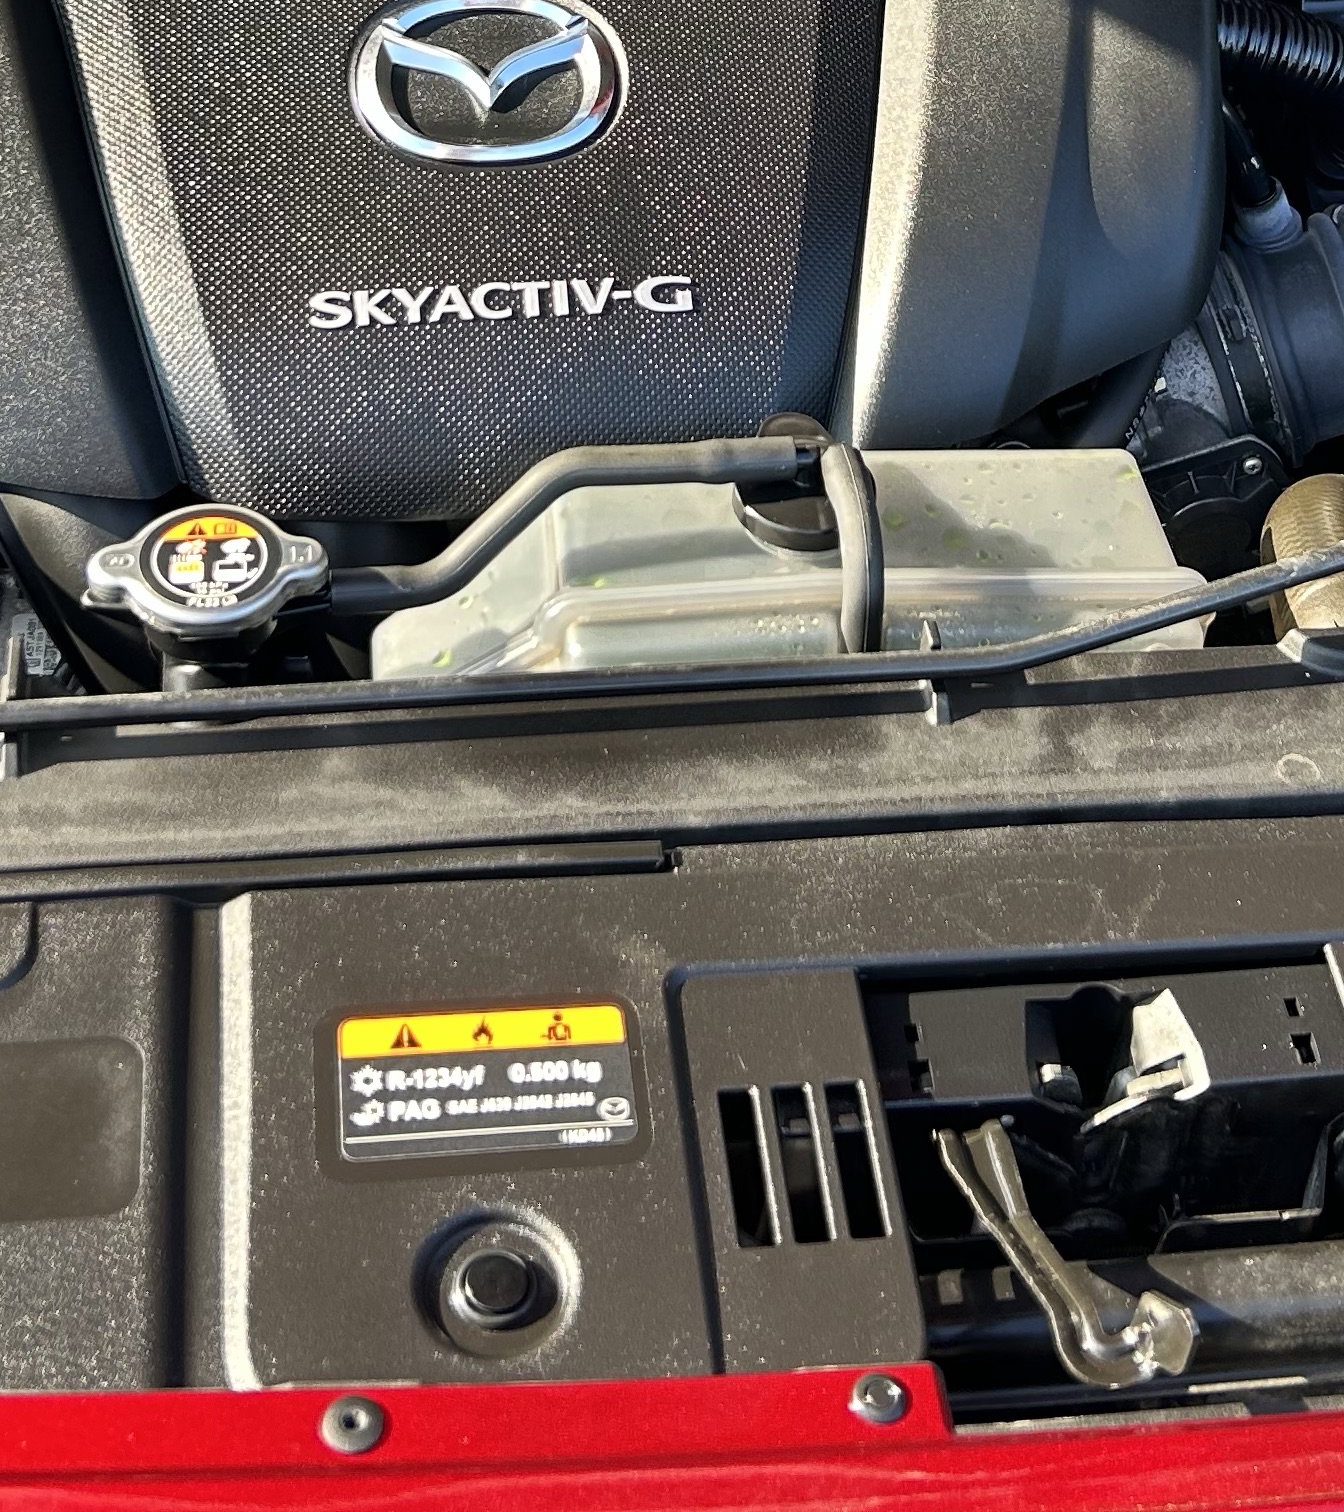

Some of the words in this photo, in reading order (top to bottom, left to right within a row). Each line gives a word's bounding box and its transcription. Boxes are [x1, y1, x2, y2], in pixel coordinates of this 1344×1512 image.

[307, 275, 694, 330] SKYACTIV-G
[289, 544, 313, 563] 1.1
[386, 1064, 486, 1091] R-1234yf
[507, 1060, 570, 1084] 0.500
[571, 1058, 604, 1083] kg
[387, 1098, 442, 1122] PAG
[445, 1099, 479, 1115] SAE
